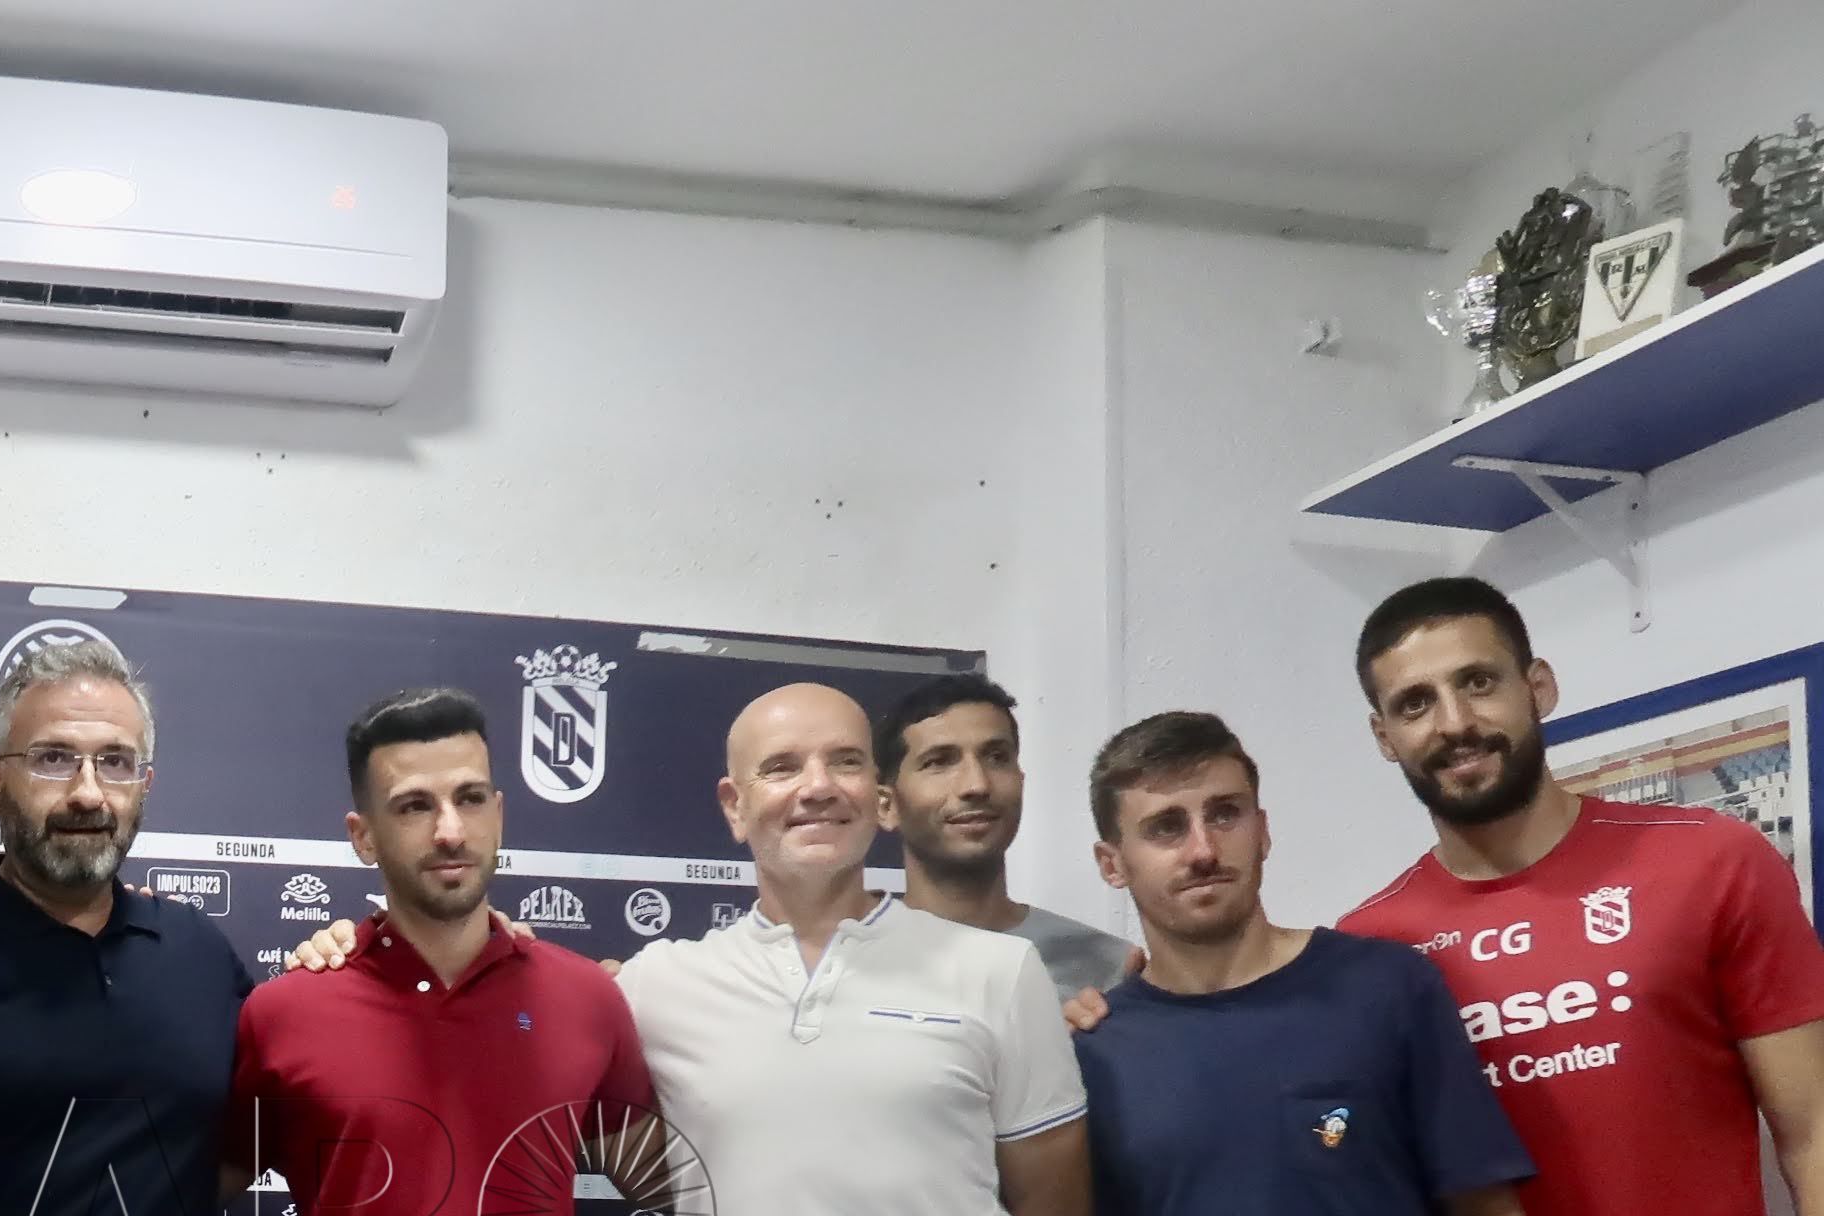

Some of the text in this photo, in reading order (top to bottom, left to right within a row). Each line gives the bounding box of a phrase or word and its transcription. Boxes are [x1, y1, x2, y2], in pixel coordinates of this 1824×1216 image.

[216, 841, 276, 858] SEGUNDA
[685, 863, 742, 880] SEGUNDA
[156, 874, 221, 894] IMPULSO23
[280, 907, 331, 921] Melilla
[1470, 921, 1532, 962] CG
[257, 947, 282, 963] CAFÉ
[1458, 970, 1632, 1043] ase:
[1508, 1042, 1622, 1083] Center
